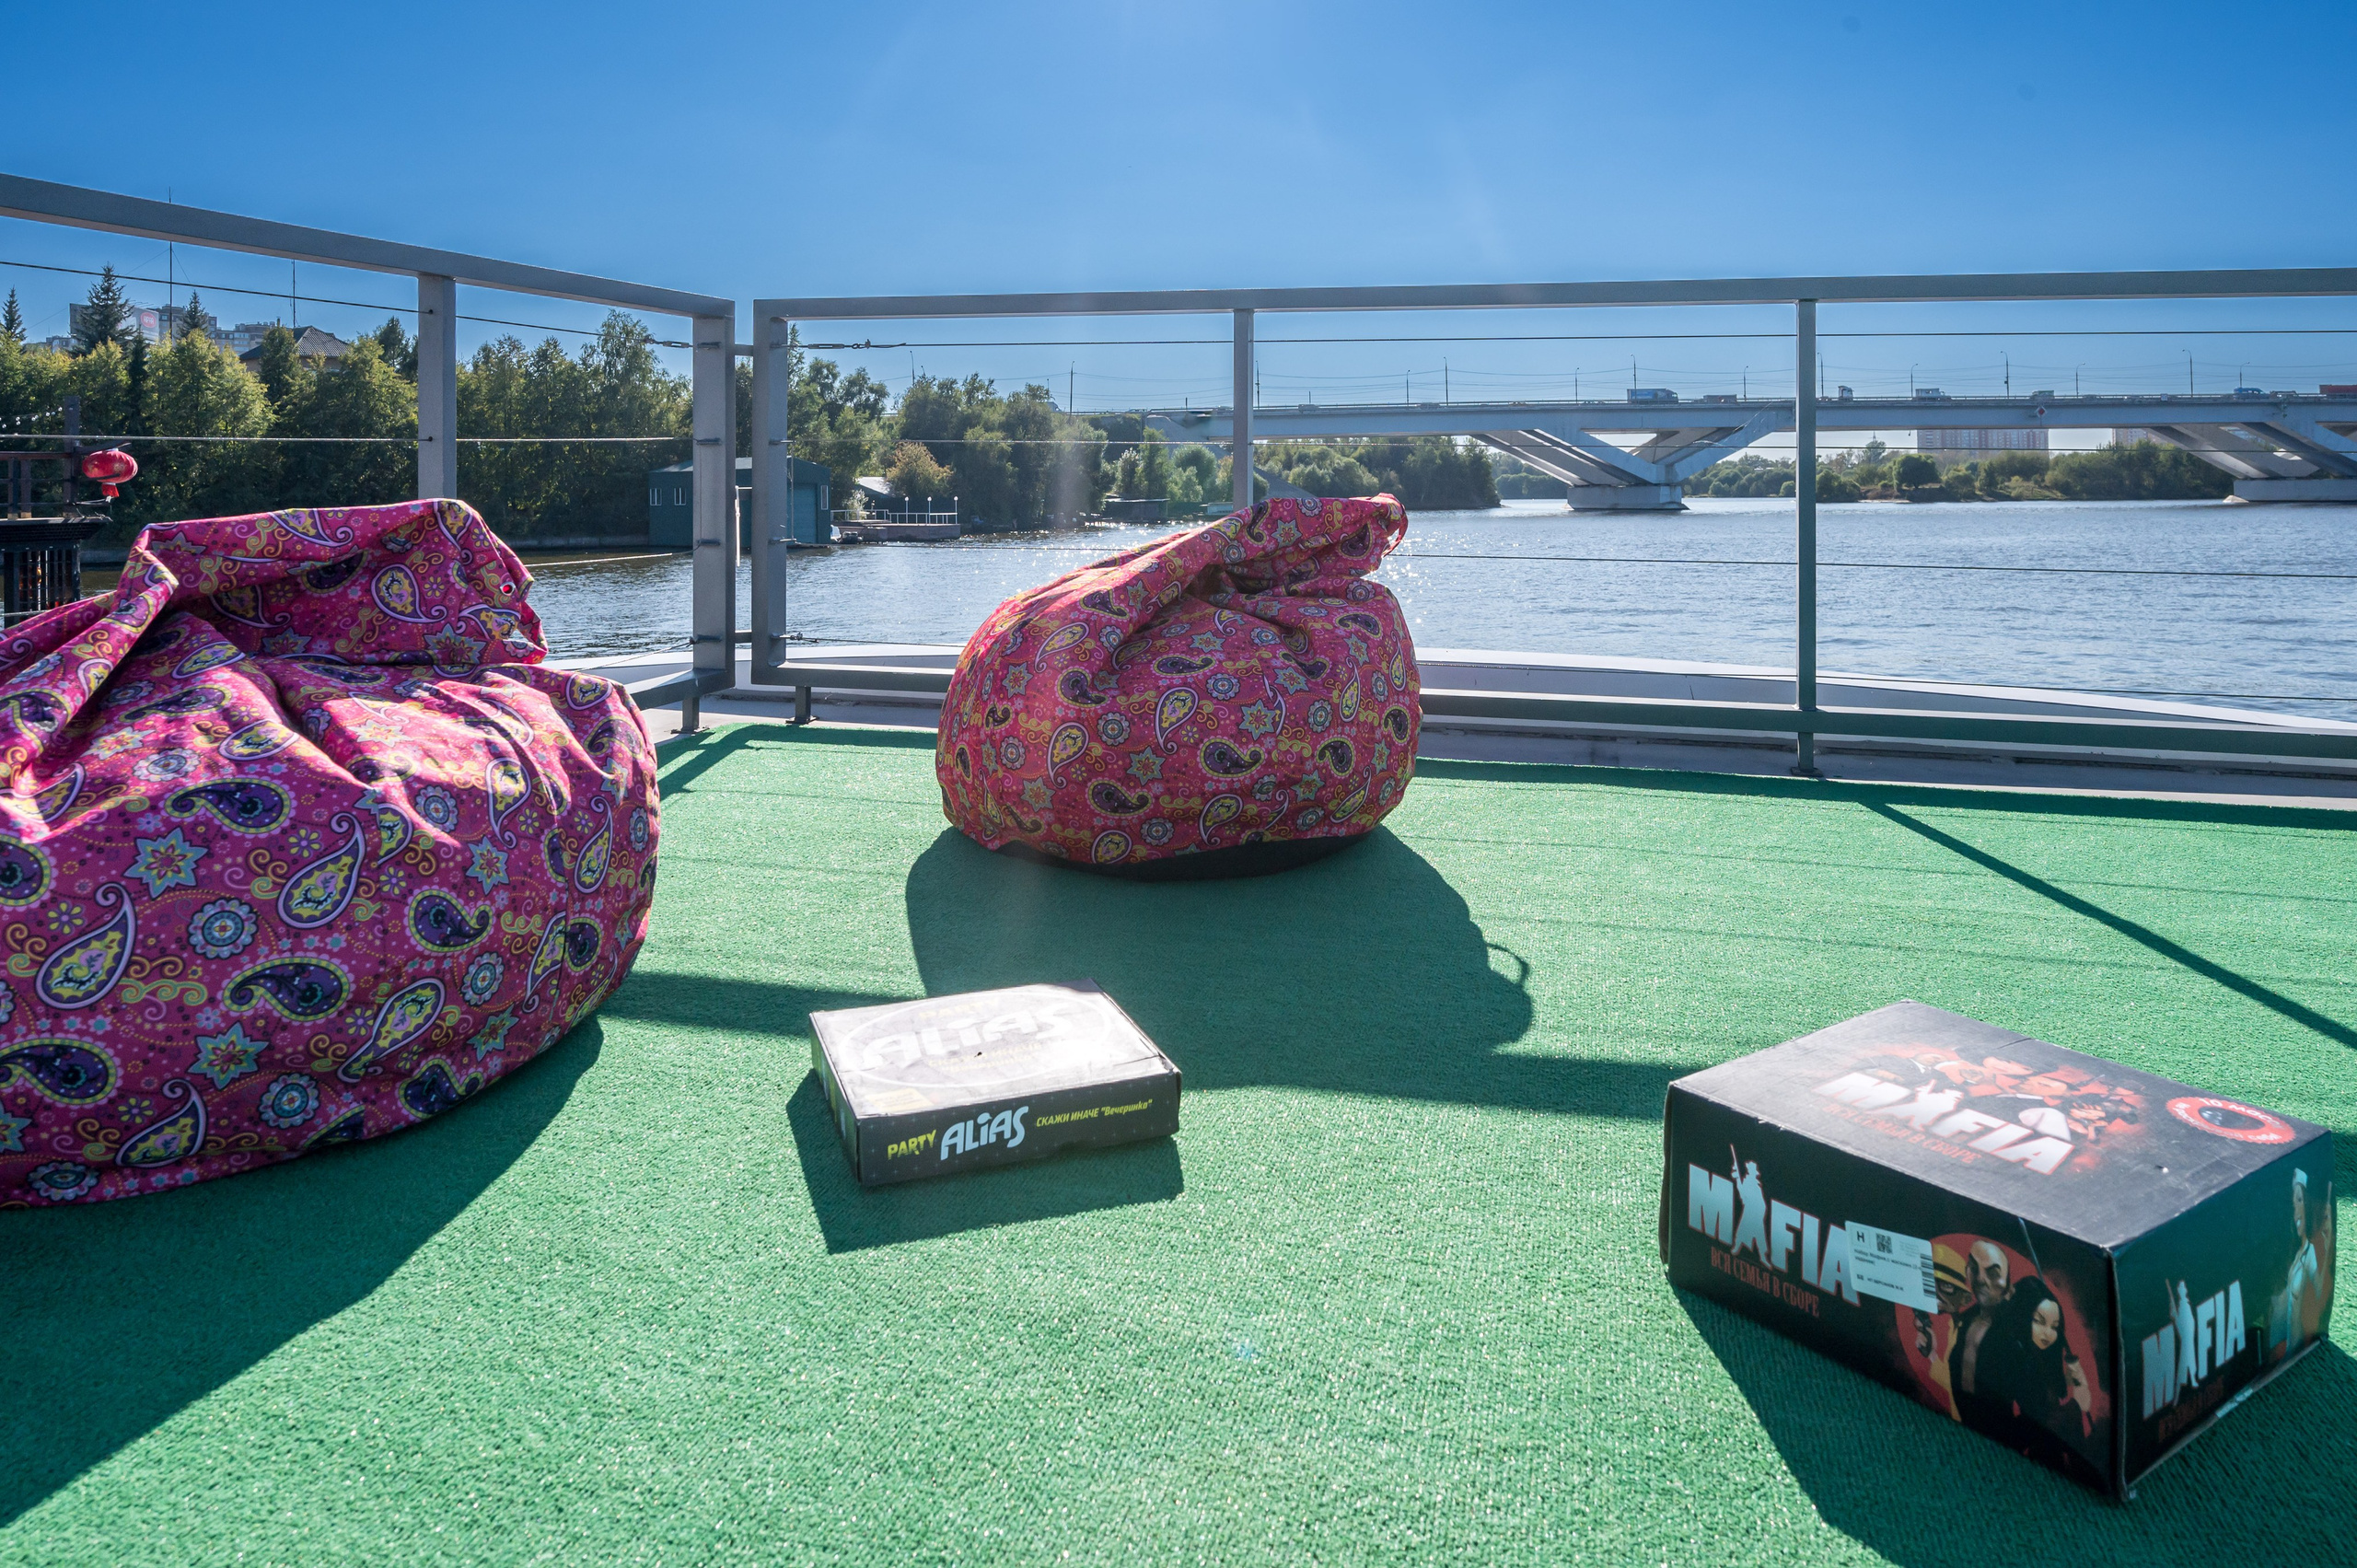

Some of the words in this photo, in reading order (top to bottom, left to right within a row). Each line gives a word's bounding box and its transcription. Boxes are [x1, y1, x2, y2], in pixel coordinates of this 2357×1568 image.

[1036, 1112, 1070, 1128] СКАЖИ
[1070, 1108, 1100, 1122] ИНАЧЕ
[887, 1129, 937, 1160] PARTY
[1711, 1246, 1731, 1274] ВСЯ
[1733, 1254, 1771, 1294] СЕМЬЯ
[1772, 1276, 1781, 1298] В
[1782, 1282, 1820, 1318] СБОРЕ
